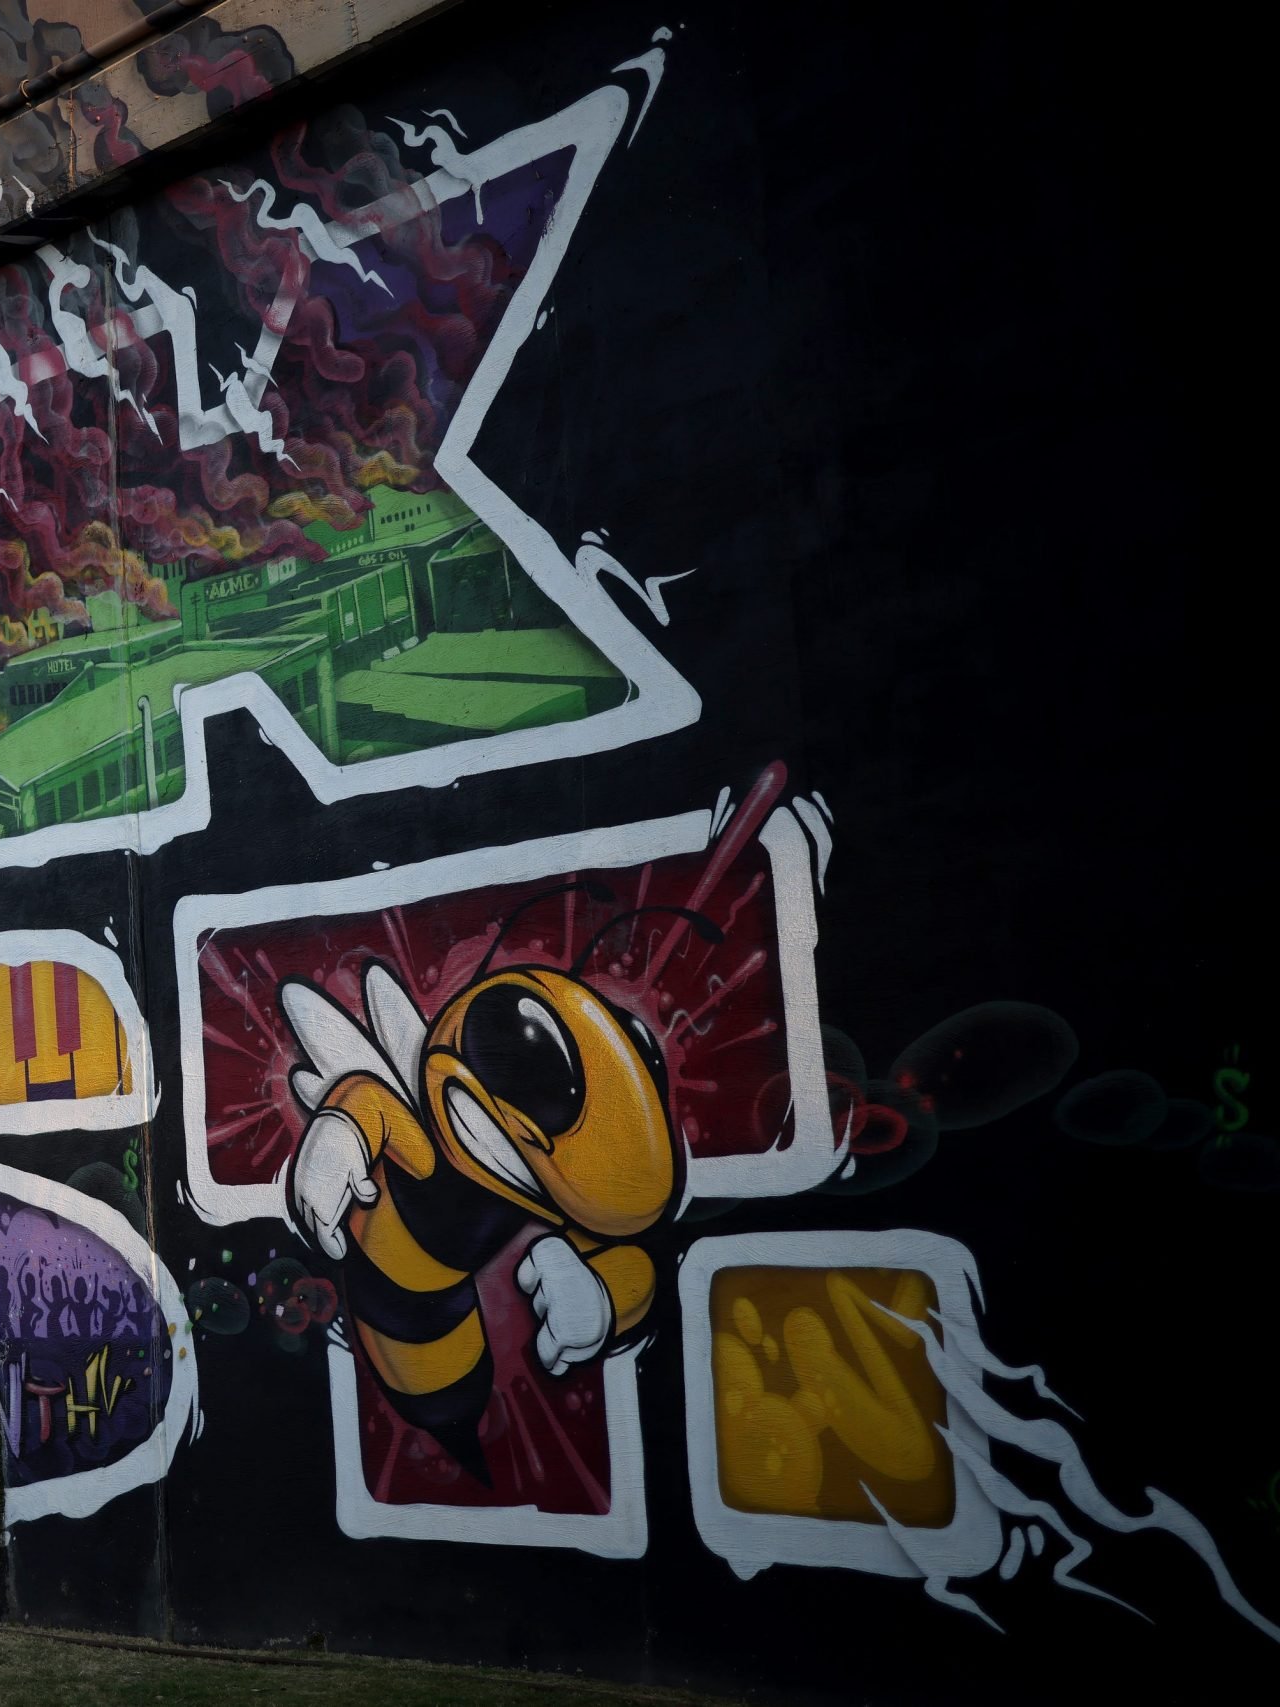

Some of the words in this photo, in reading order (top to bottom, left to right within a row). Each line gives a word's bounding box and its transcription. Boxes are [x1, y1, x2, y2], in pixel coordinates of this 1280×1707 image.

[358, 554, 377, 566] GAS
[388, 549, 407, 561] OIL
[47, 658, 77, 673] HOTEL
